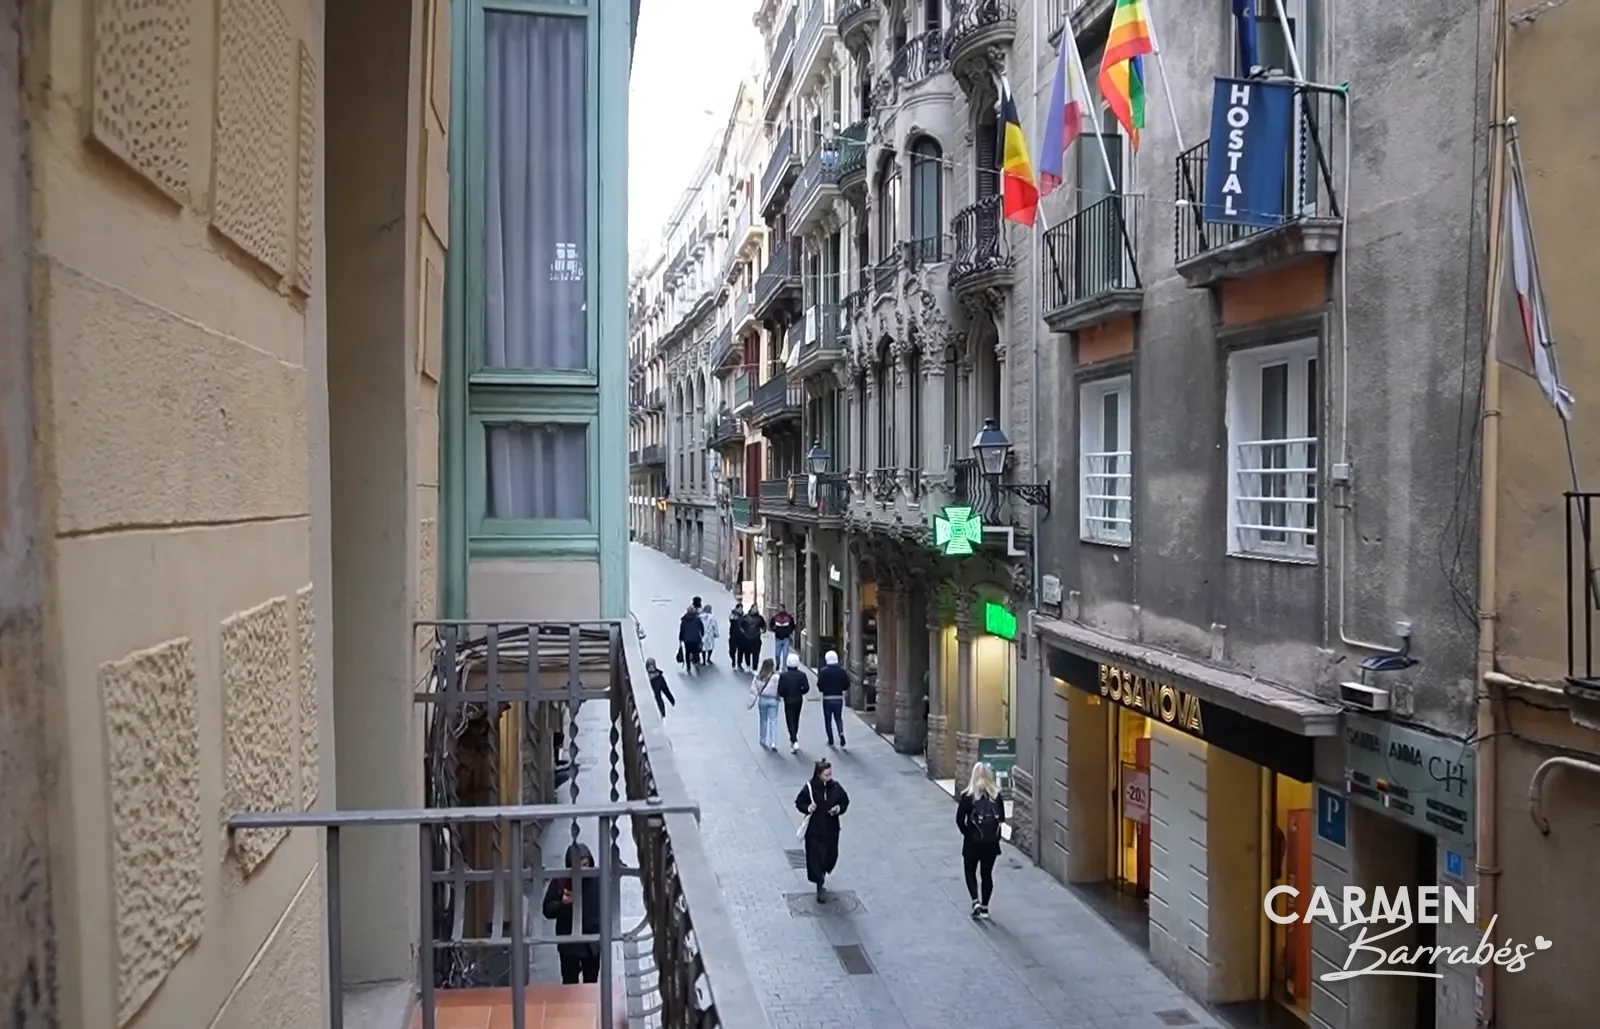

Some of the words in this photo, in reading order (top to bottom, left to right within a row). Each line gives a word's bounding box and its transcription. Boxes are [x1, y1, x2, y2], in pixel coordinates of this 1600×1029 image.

[1222, 84, 1250, 215] HOSTAL
[1100, 664, 1204, 735] BOSANOVA
[1327, 797, 1340, 824] P
